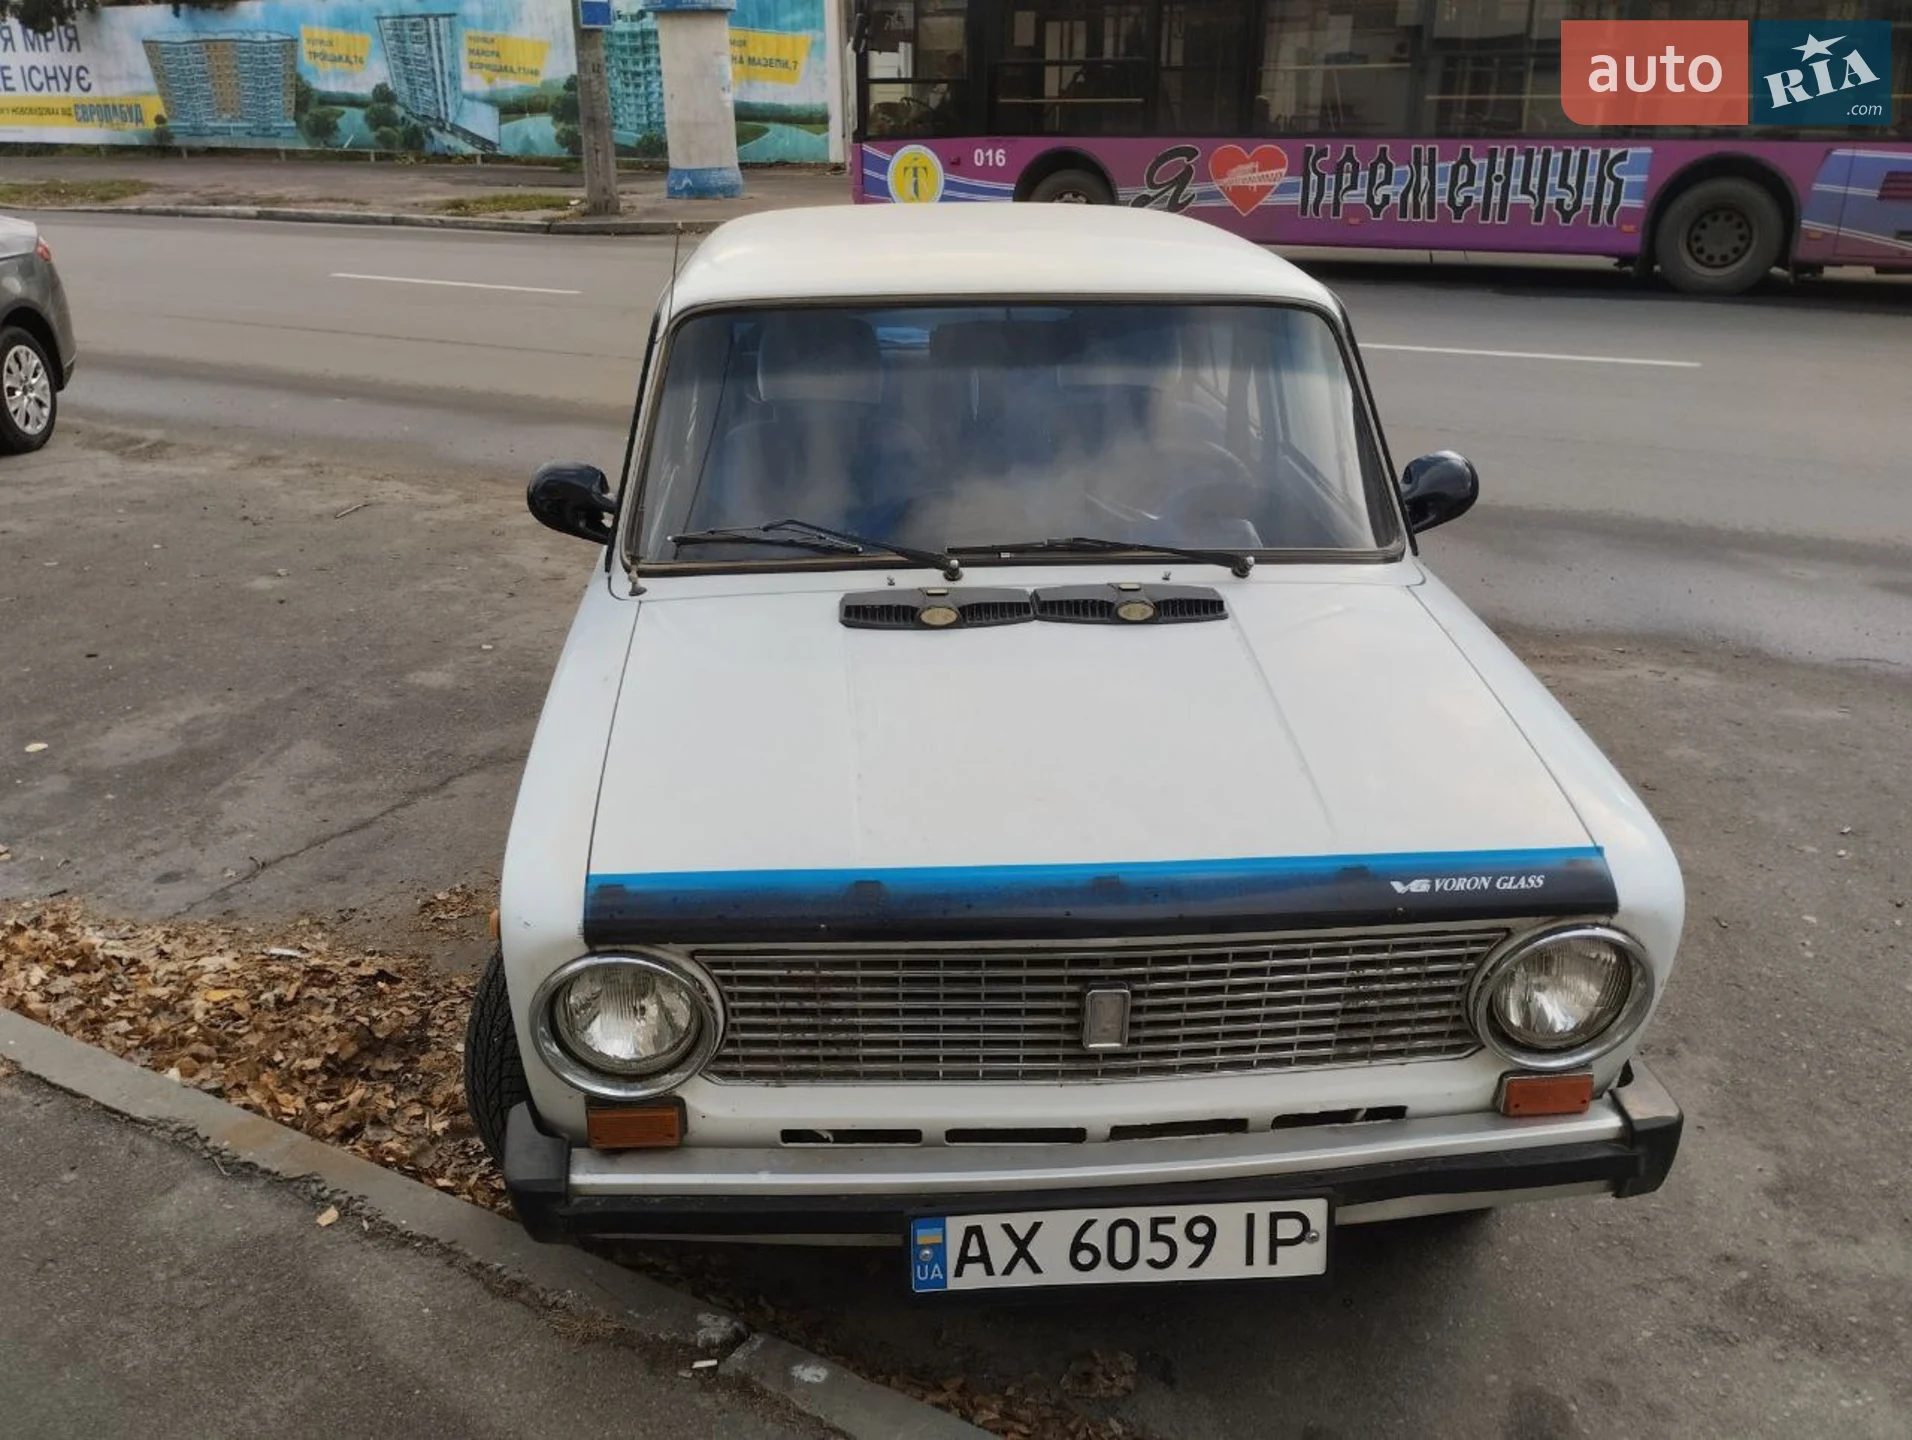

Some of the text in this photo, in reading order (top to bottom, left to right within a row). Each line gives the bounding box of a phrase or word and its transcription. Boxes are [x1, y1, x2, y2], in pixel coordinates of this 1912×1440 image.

[20, 22, 81, 52] МРІЯ
[20, 65, 92, 92] ІСНУЄ
[974, 148, 1006, 166] 016
[1434, 876, 1493, 893] VORON
[1496, 874, 1546, 890] GLASS
[953, 1210, 1312, 1278] AX 6059 IP
[916, 1263, 943, 1281] UA
